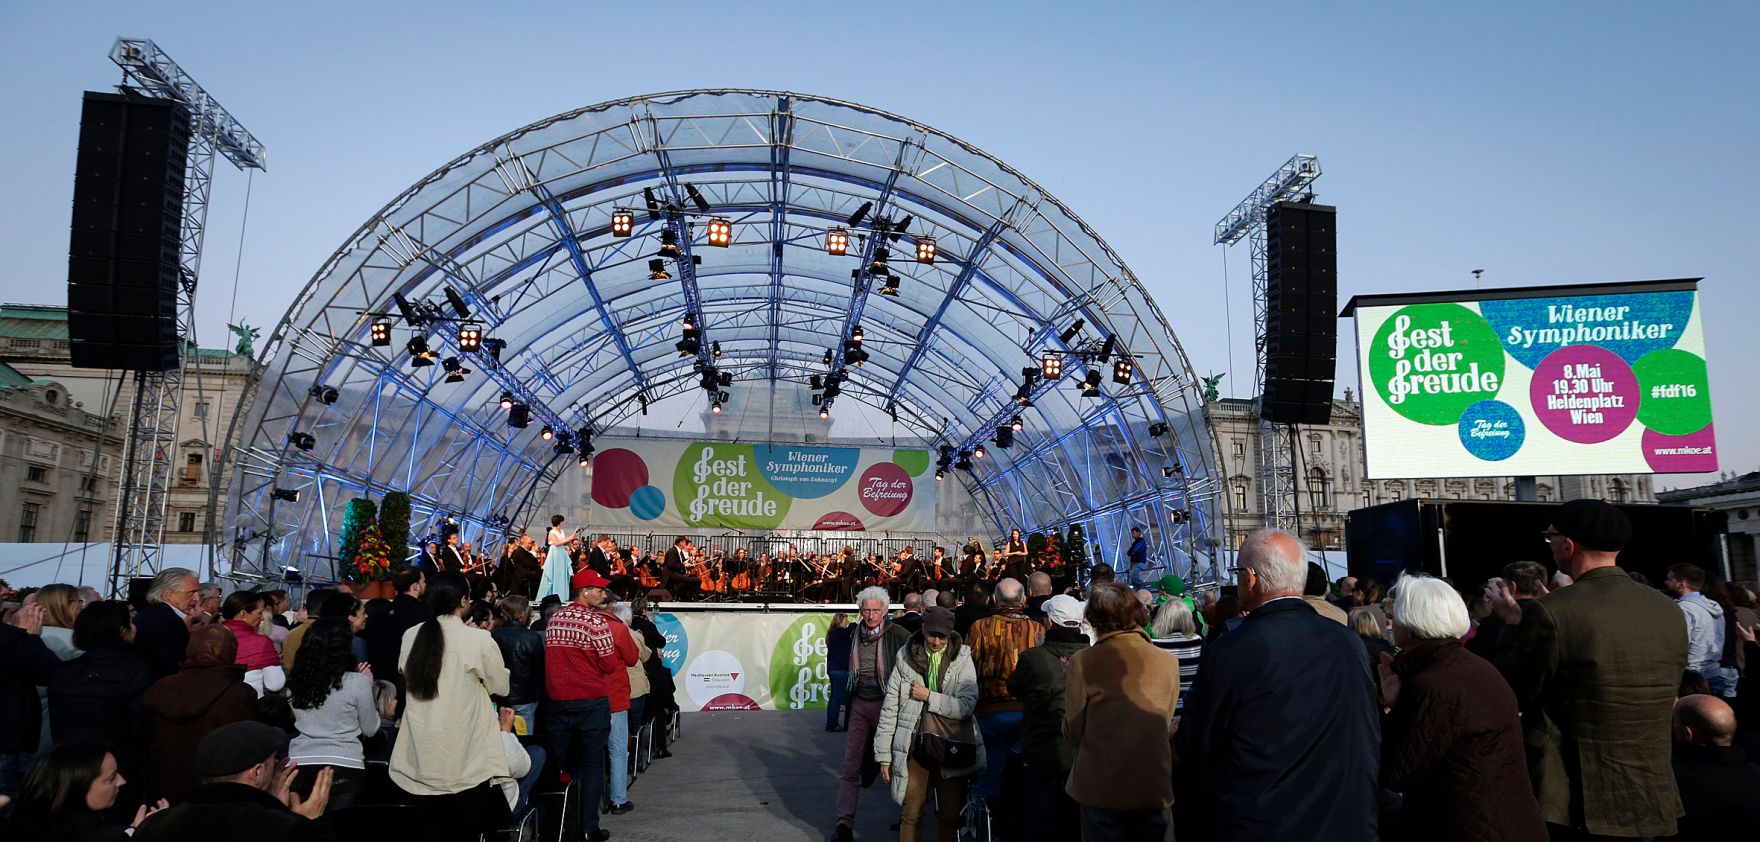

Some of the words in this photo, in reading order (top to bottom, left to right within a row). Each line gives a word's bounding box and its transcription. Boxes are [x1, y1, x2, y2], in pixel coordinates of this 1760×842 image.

[1548, 303, 1630, 324] Wiener
[1387, 314, 1455, 359] Fest
[1507, 320, 1673, 348] Symphoniker
[1414, 348, 1463, 372] der
[1387, 359, 1498, 405] Freude
[1553, 379, 1589, 395] 19.30
[1591, 378, 1615, 393] Uhr
[1650, 384, 1697, 399] #fdf16
[1547, 393, 1625, 411] Heldenplatz
[1474, 419, 1492, 430] Tag
[1494, 420, 1508, 429] der
[1569, 409, 1604, 425] Wien
[1470, 428, 1510, 440] Befreiung
[788, 451, 829, 463] Wiener
[1654, 445, 1713, 456] www.mkoe.at
[693, 446, 747, 484] Fest
[766, 461, 848, 474] Symphoniker
[712, 476, 752, 497] der
[770, 475, 798, 483] Christoph
[868, 477, 888, 489] Tag
[891, 479, 907, 489] der
[863, 487, 908, 502] Befreiung
[689, 484, 777, 523] Freude
[793, 622, 829, 666] Fe
